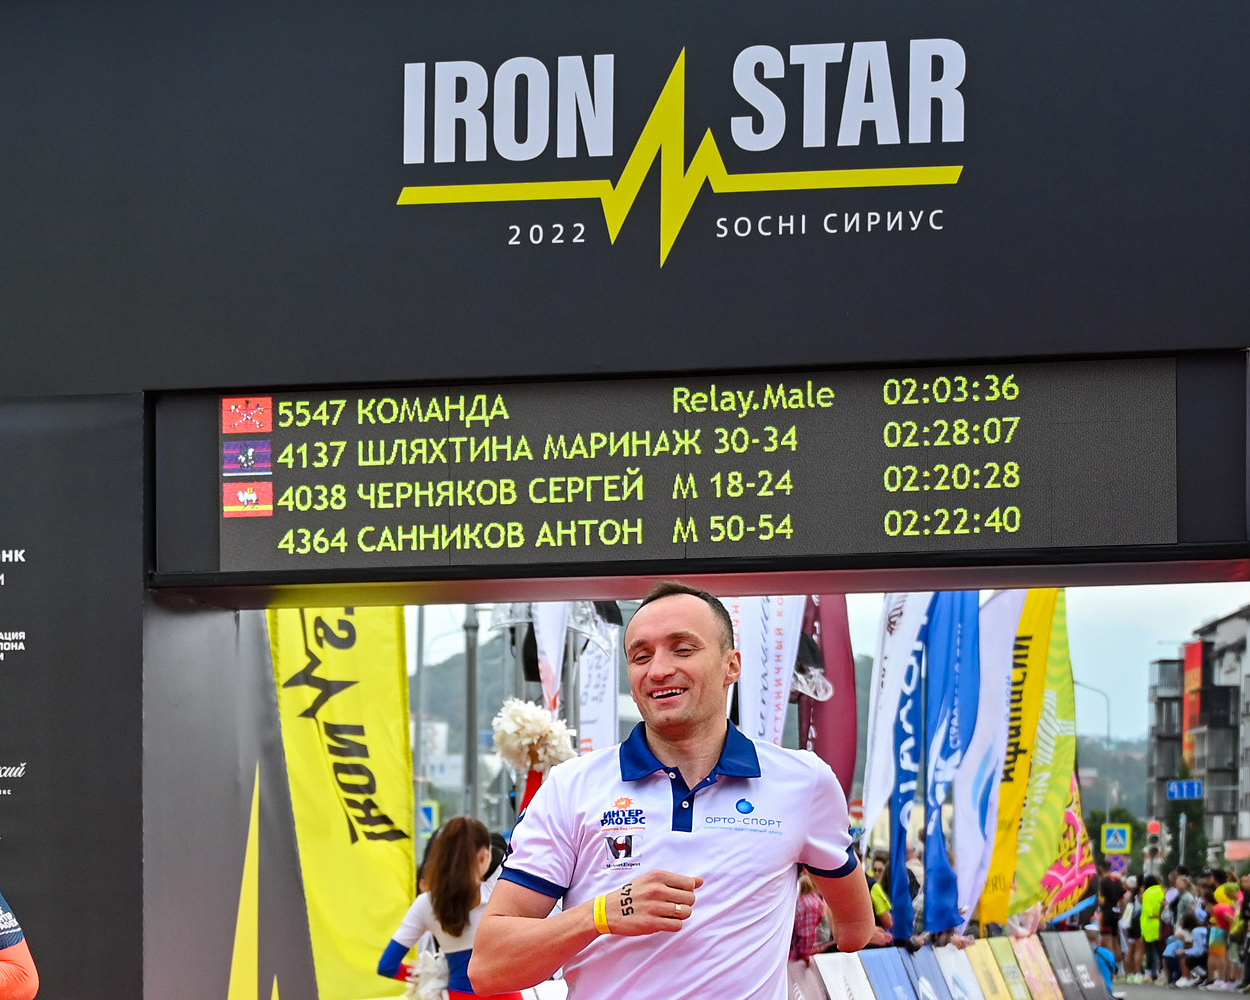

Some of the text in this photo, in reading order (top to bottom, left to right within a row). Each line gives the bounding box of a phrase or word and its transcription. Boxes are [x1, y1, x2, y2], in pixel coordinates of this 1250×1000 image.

[403, 38, 967, 164] IRON STAR
[508, 210, 944, 245] 2022 SOCHI СИРИУС
[278, 400, 347, 428] 5547
[357, 394, 510, 428] КОМАНДА
[883, 374, 1020, 405] 02:03:36
[277, 441, 348, 469] 4137
[357, 435, 534, 467] ШЛЯХТИНА
[714, 425, 798, 454] 30-34
[883, 416, 1021, 448] 02:28:07
[277, 484, 347, 512] 4038
[357, 479, 518, 509] ЧЕРНЯКОВ
[529, 467, 644, 503] СЕРГЕЙ
[710, 470, 794, 498] 18-24
[883, 461, 1020, 492] 02:20:28
[278, 529, 348, 555] 4364
[357, 522, 525, 552] САННИКОВ
[535, 519, 643, 547] АНТОН
[710, 513, 794, 542] 50-54
[883, 506, 1021, 536] 02:22:40
[705, 816, 783, 828] ОРТО-СПОРТ
